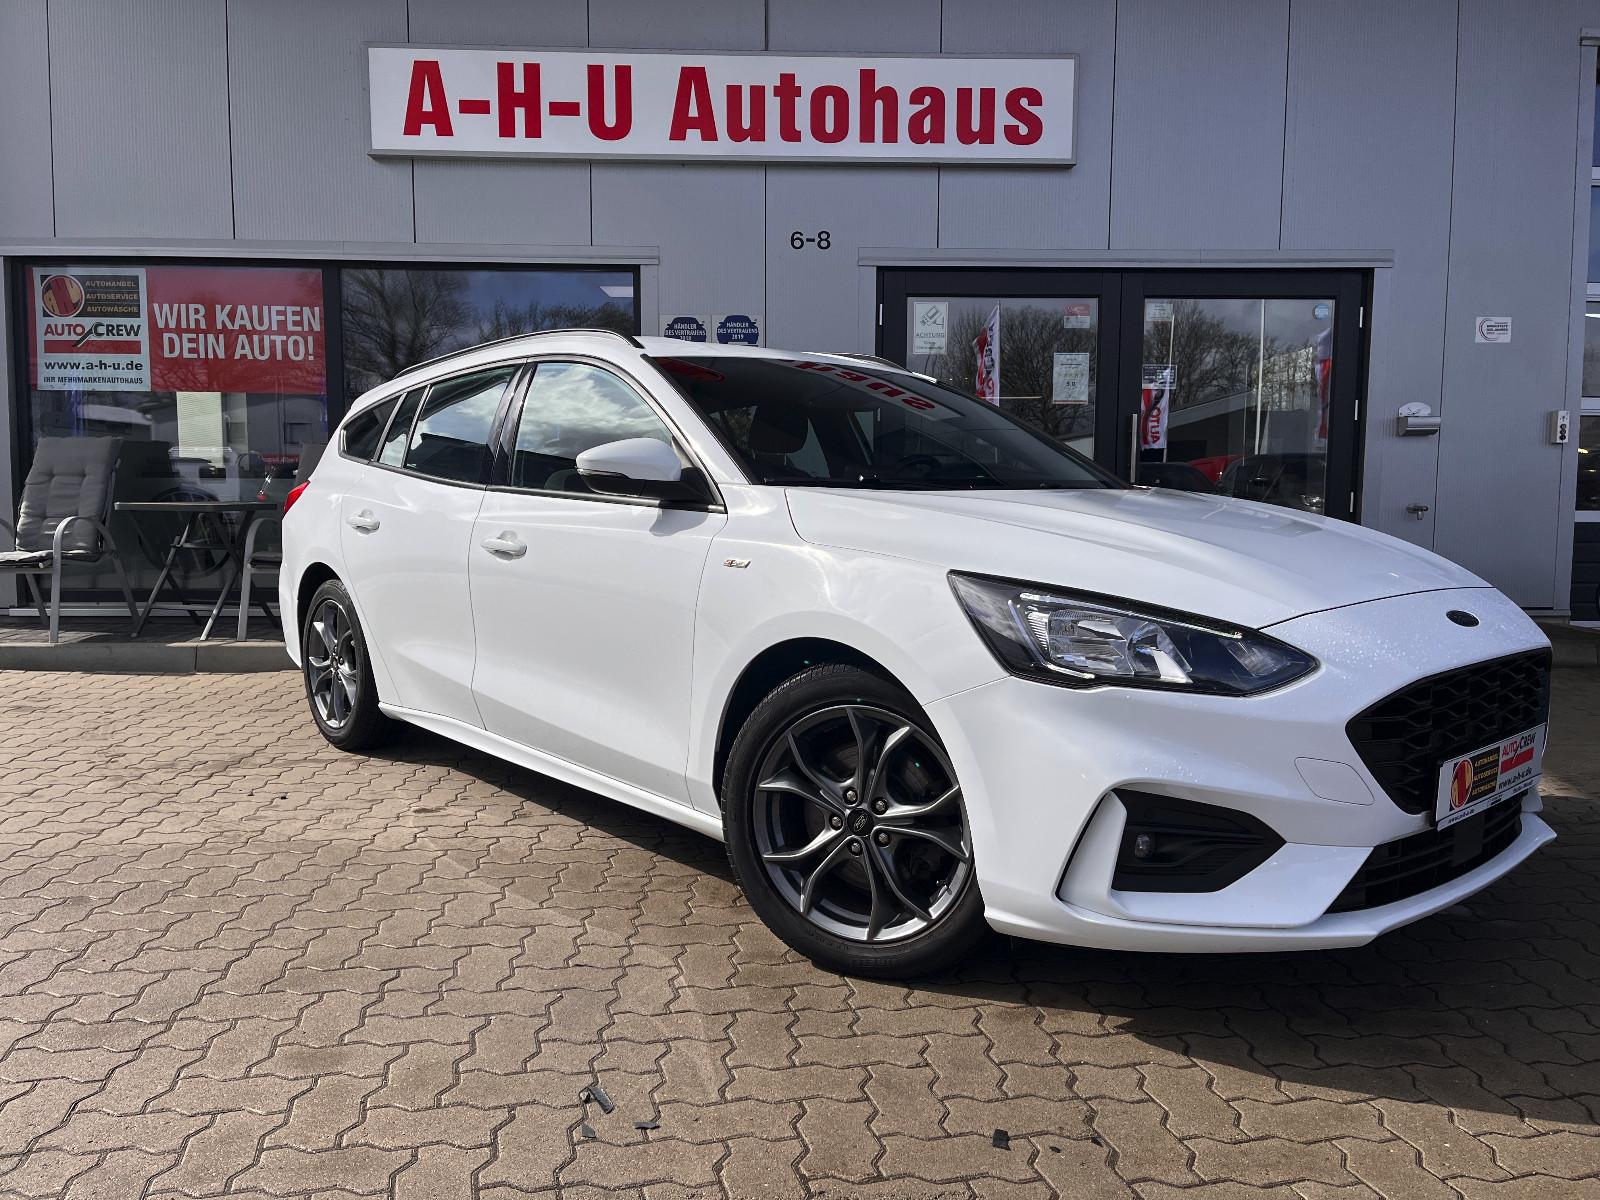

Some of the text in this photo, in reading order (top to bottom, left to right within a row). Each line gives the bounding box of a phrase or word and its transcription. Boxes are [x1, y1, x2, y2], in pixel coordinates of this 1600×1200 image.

[403, 60, 1043, 146] A-H-U Autohaus
[791, 231, 831, 250] 6-8
[153, 303, 321, 332] WIR KAUFEN
[44, 321, 141, 338] AUTO CREW
[163, 333, 315, 361] DEIN AUTO!
[44, 360, 143, 371] www.a-h-u.de
[57, 376, 143, 384] MEHRMARKENAUTOHAUS
